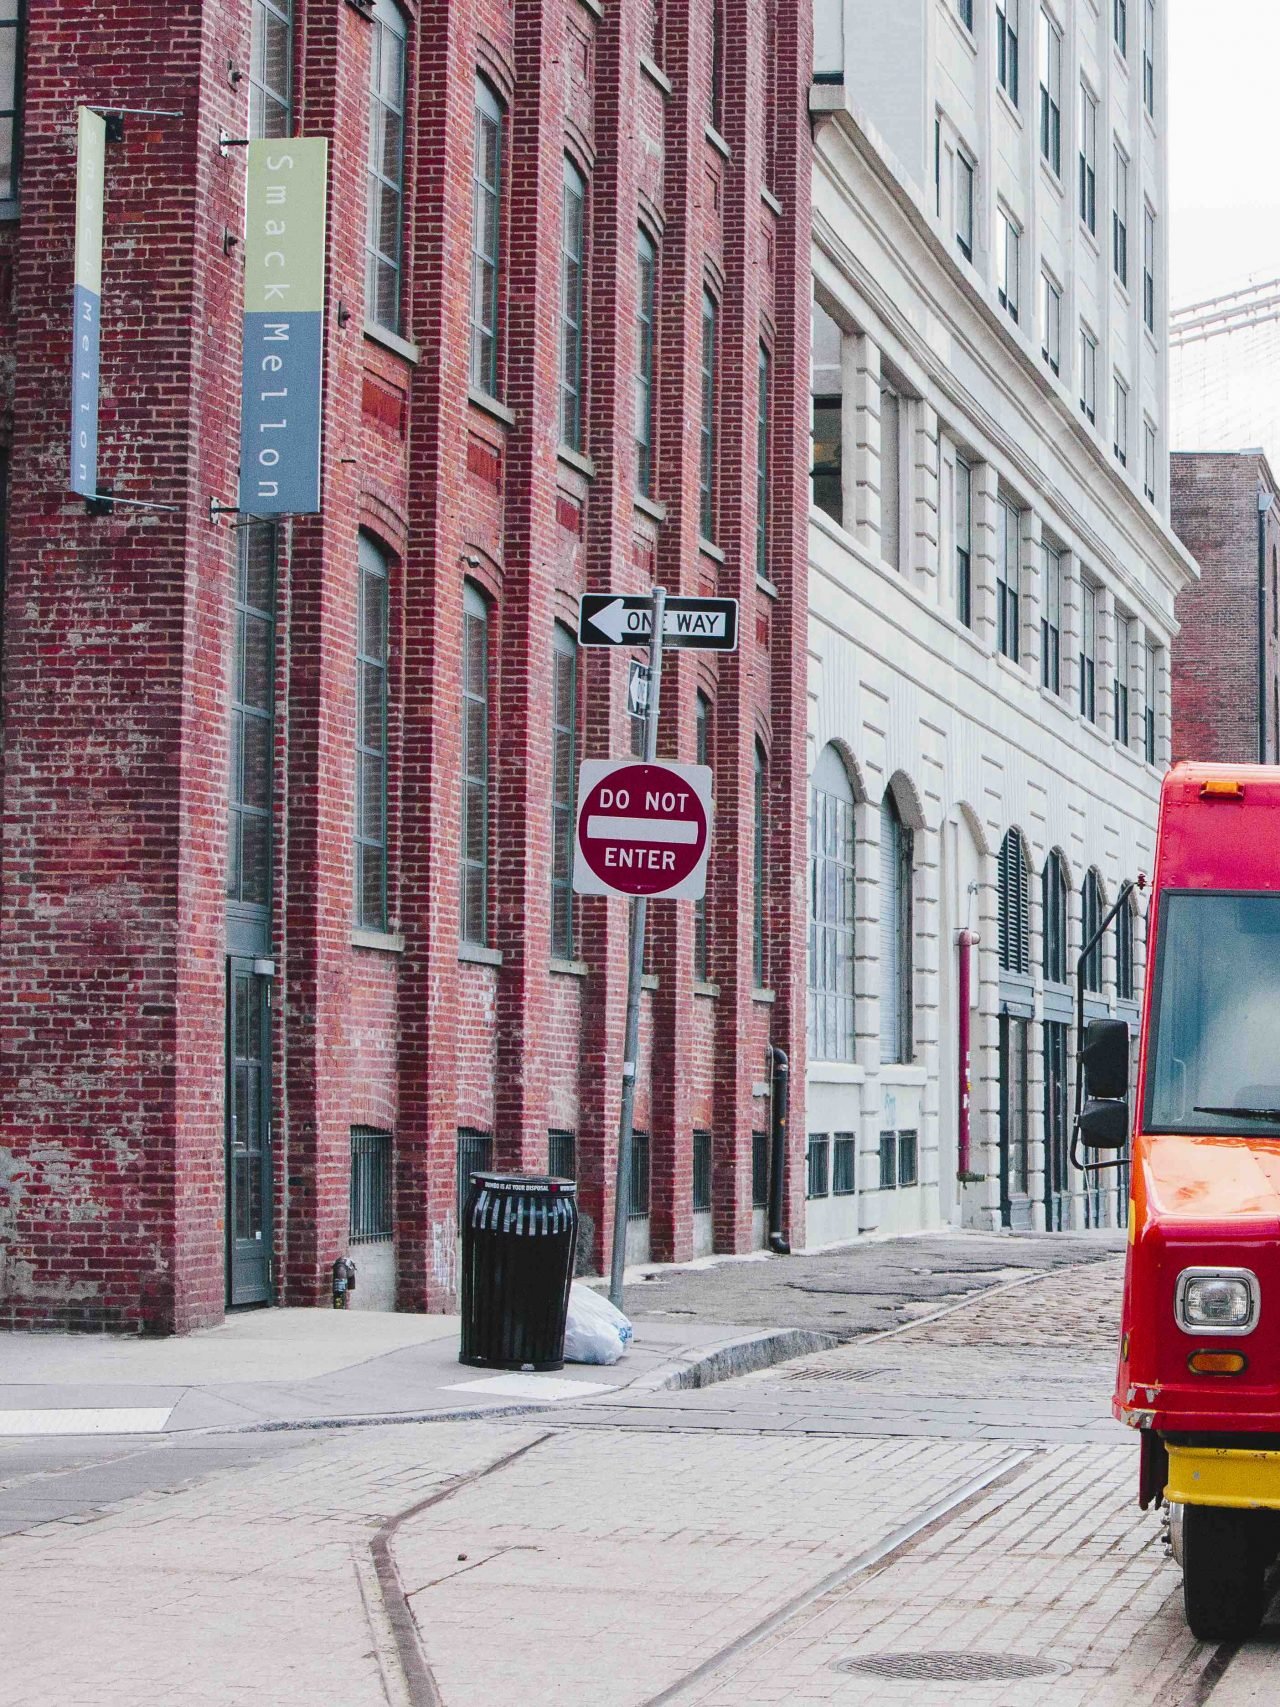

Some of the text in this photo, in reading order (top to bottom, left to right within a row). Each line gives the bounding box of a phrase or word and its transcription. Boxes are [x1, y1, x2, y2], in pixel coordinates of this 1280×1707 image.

[257, 154, 294, 497] Smack Mellon
[79, 301, 92, 481] Mellon
[677, 613, 719, 633] WAY
[600, 788, 689, 812] DO NOT
[604, 847, 676, 870] ENTER
